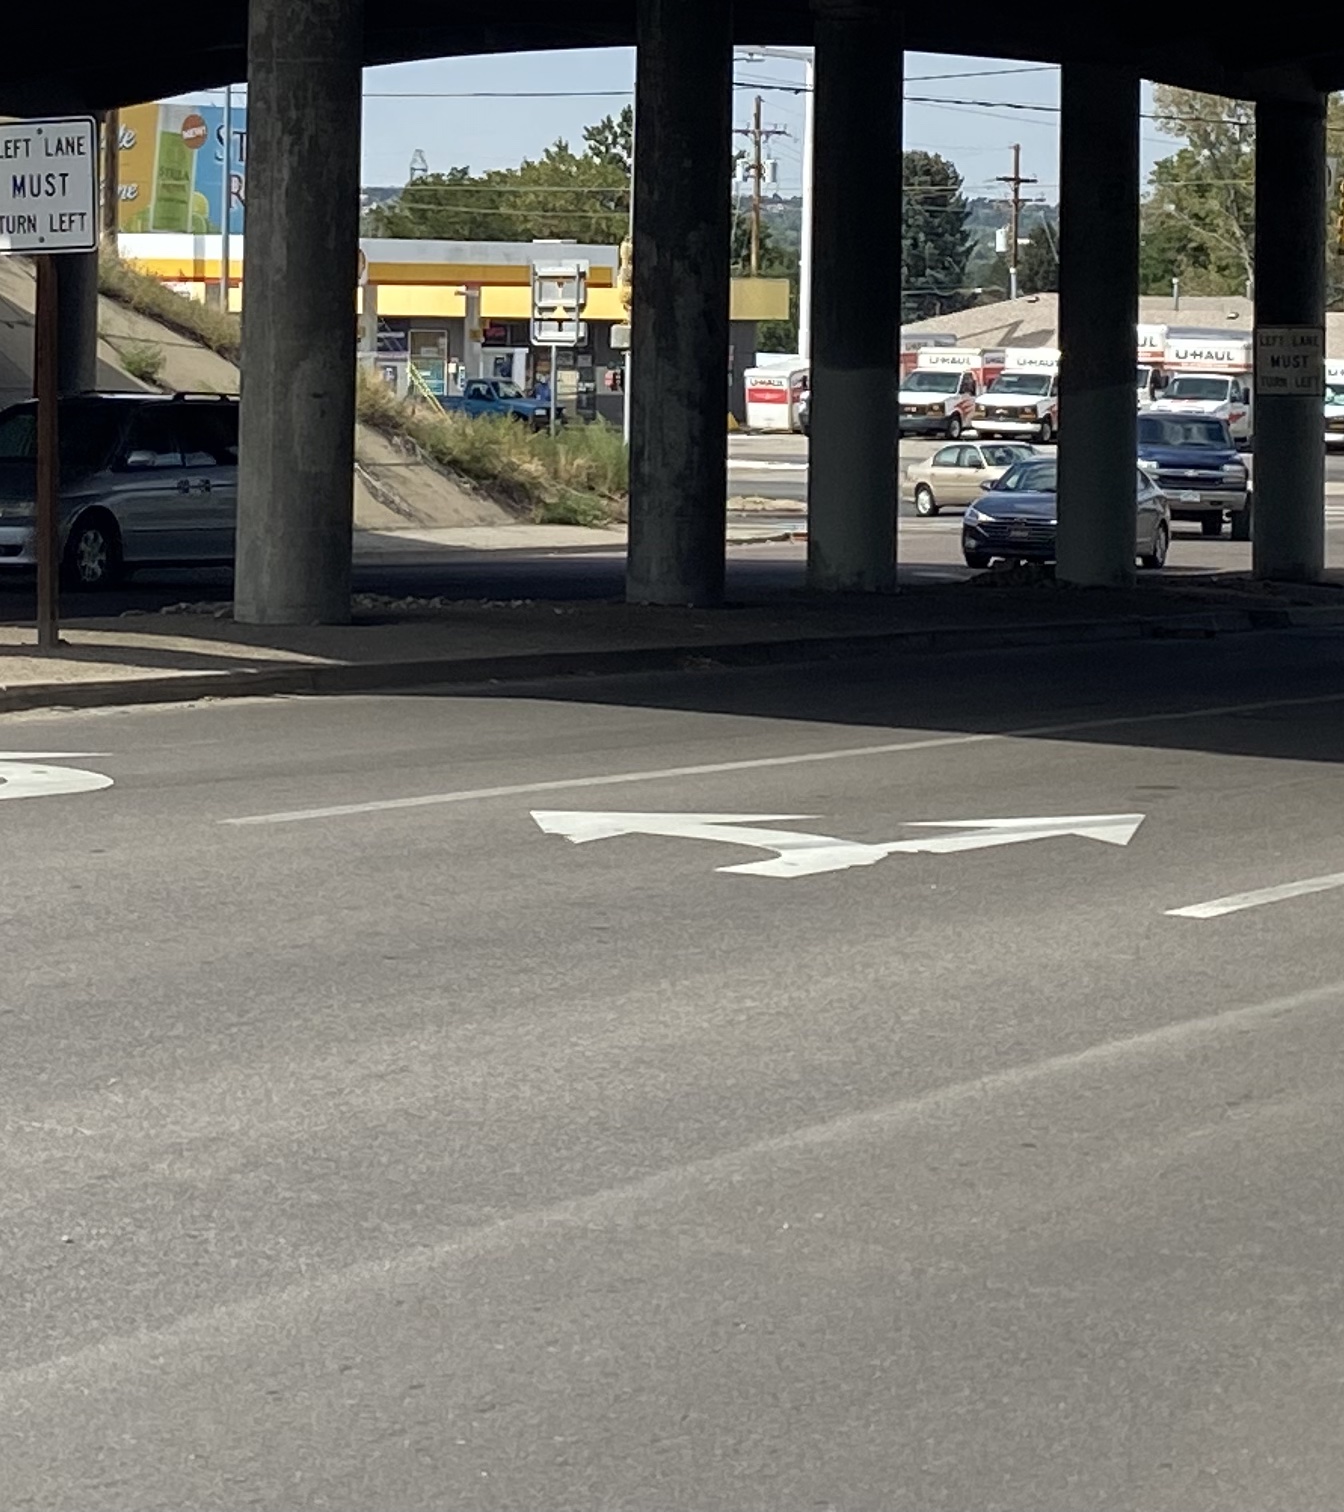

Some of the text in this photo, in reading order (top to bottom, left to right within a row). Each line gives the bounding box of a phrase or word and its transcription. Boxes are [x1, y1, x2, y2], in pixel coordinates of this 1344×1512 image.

[44, 135, 87, 157] LANE
[11, 173, 70, 199] MUST
[48, 212, 87, 233] LEFT
[1270, 355, 1309, 369] MUST
